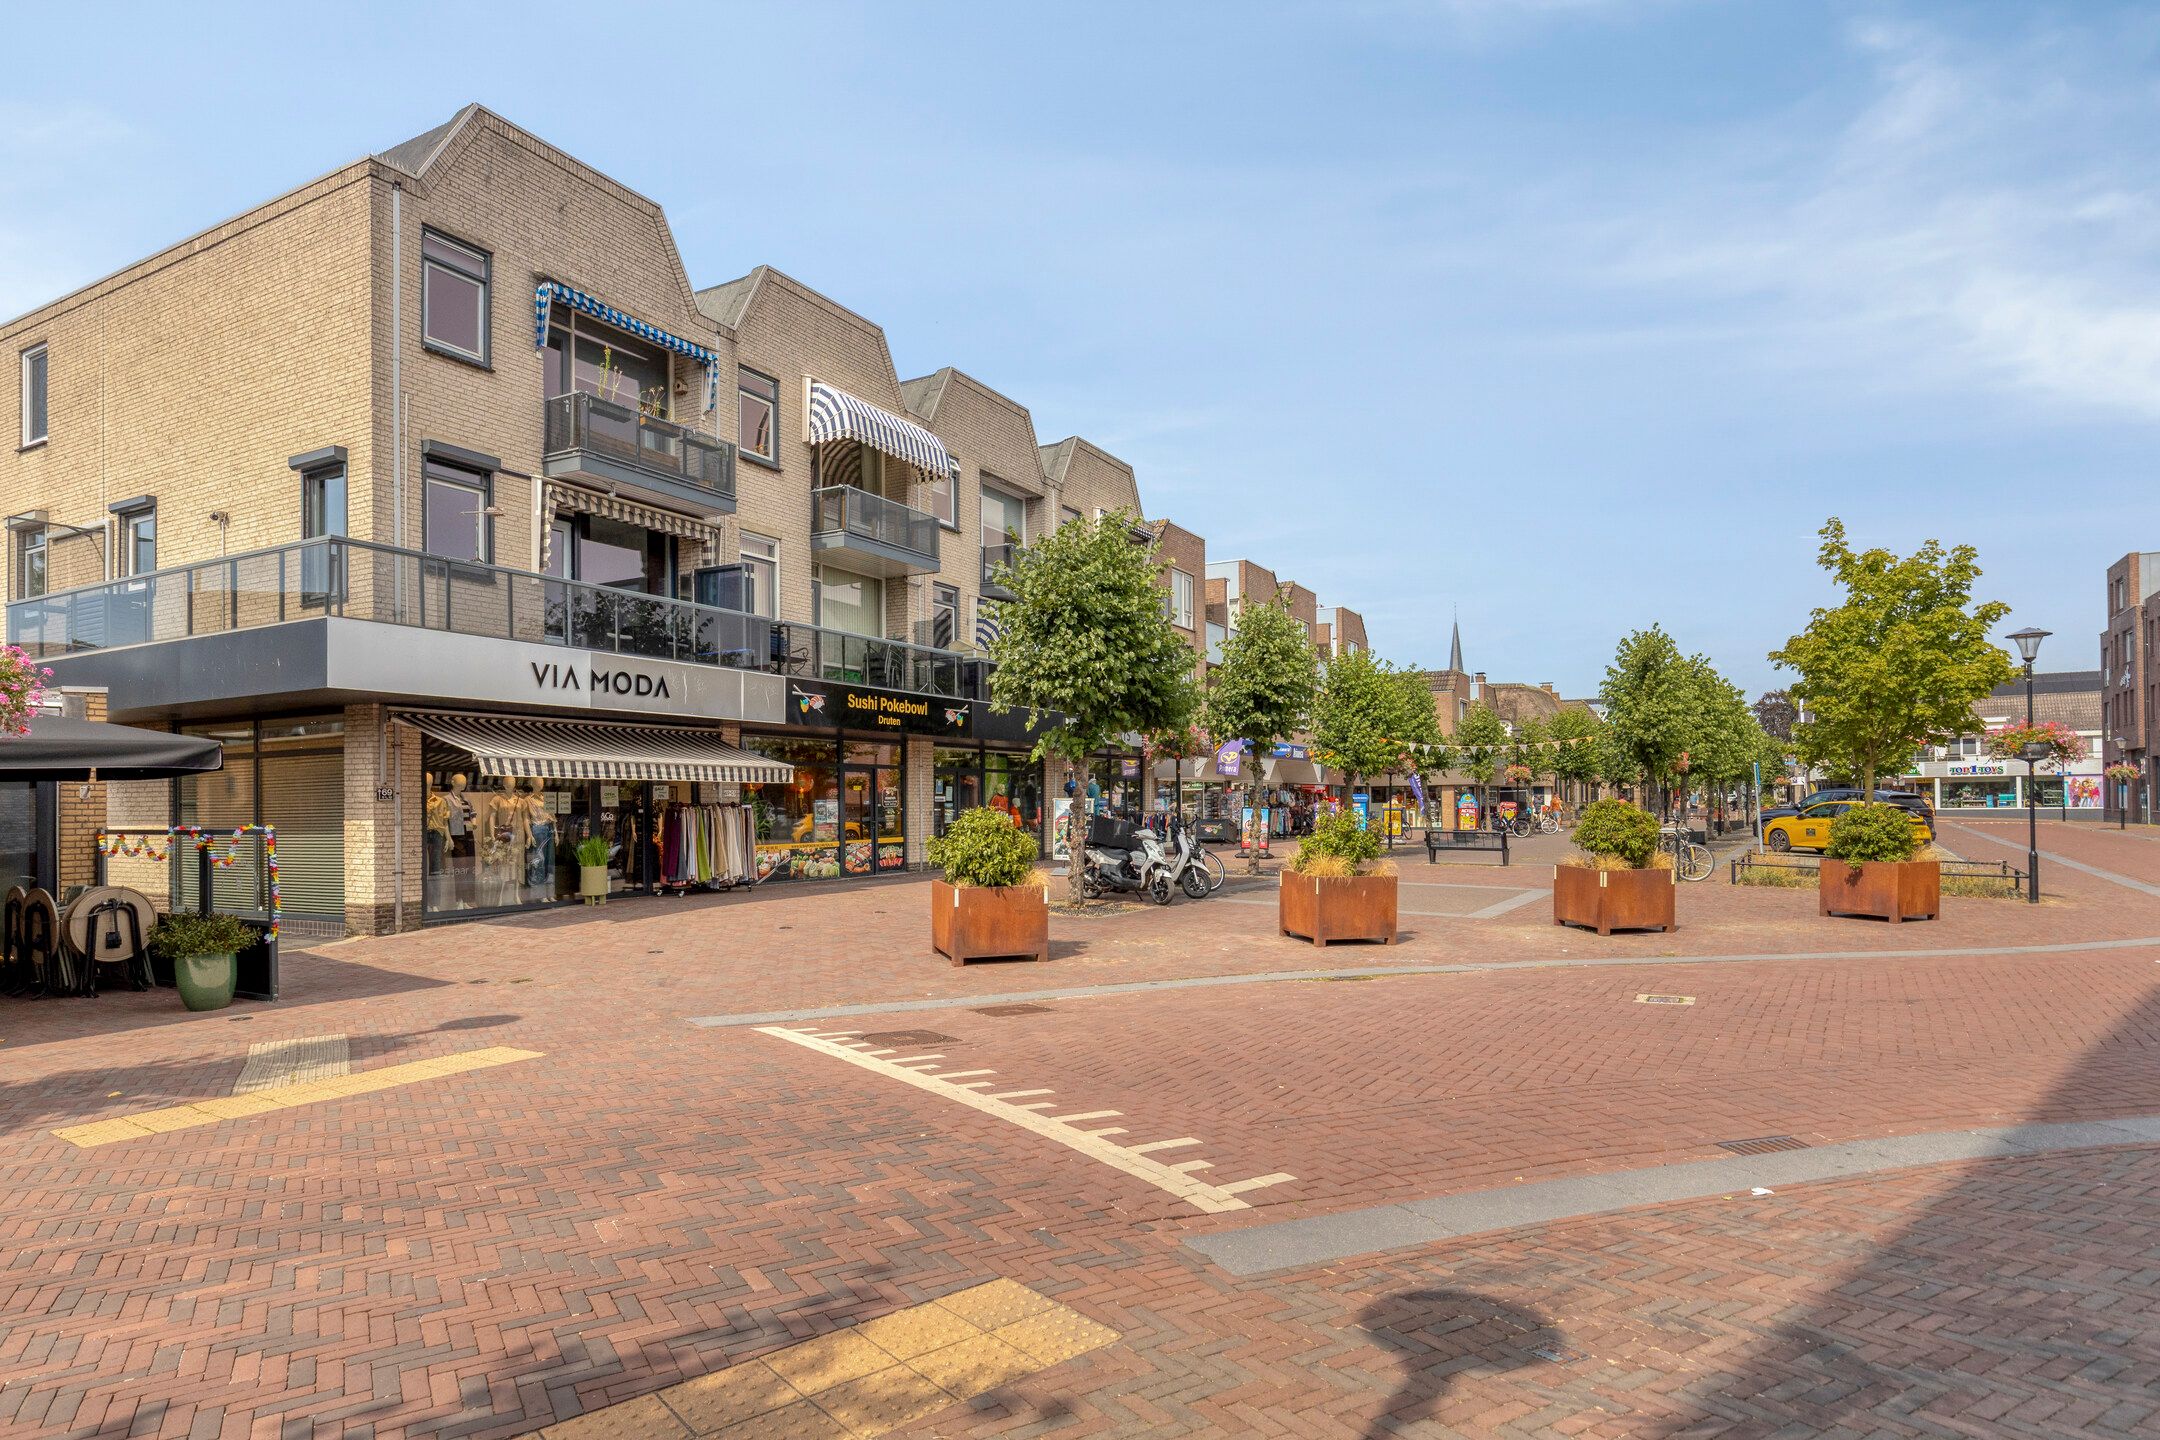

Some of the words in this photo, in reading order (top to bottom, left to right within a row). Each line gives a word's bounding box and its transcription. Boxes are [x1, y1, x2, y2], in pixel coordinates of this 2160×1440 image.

[530, 661, 581, 690] VIA
[590, 668, 671, 699] MODA
[847, 693, 878, 711] Sushi
[880, 697, 928, 716] Pokebowl
[878, 715, 901, 726] Druten
